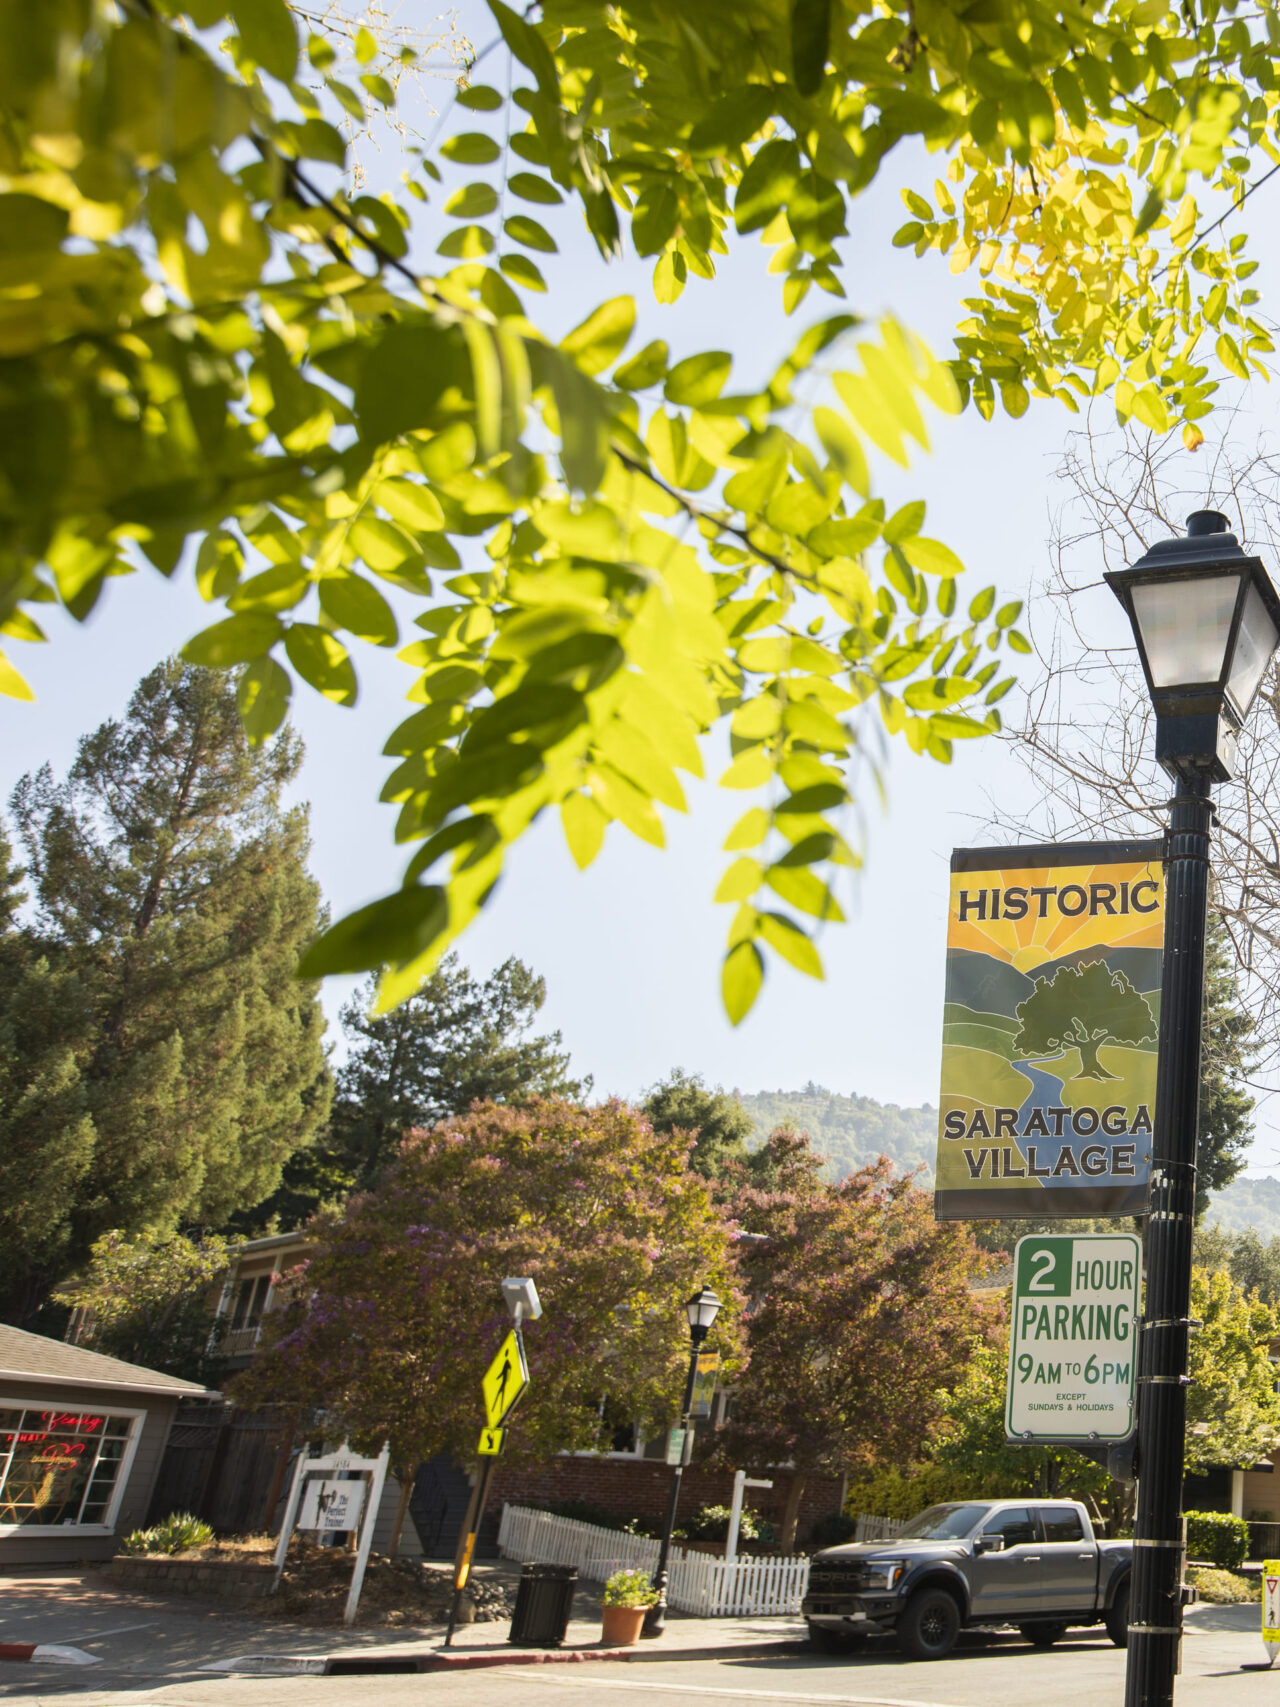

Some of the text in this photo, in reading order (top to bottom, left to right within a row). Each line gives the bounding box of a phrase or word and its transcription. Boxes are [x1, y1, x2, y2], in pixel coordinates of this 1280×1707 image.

[958, 880, 1160, 922] HISTORIC
[943, 1104, 1153, 1140] SARATOGA
[962, 1143, 1136, 1179] VILLAGE
[1029, 1249, 1133, 1291] 2 HOUR
[1021, 1303, 1129, 1341] PARKING
[1065, 1363, 1081, 1375] TO
[1028, 1403, 1064, 1411] SUNDAYS
